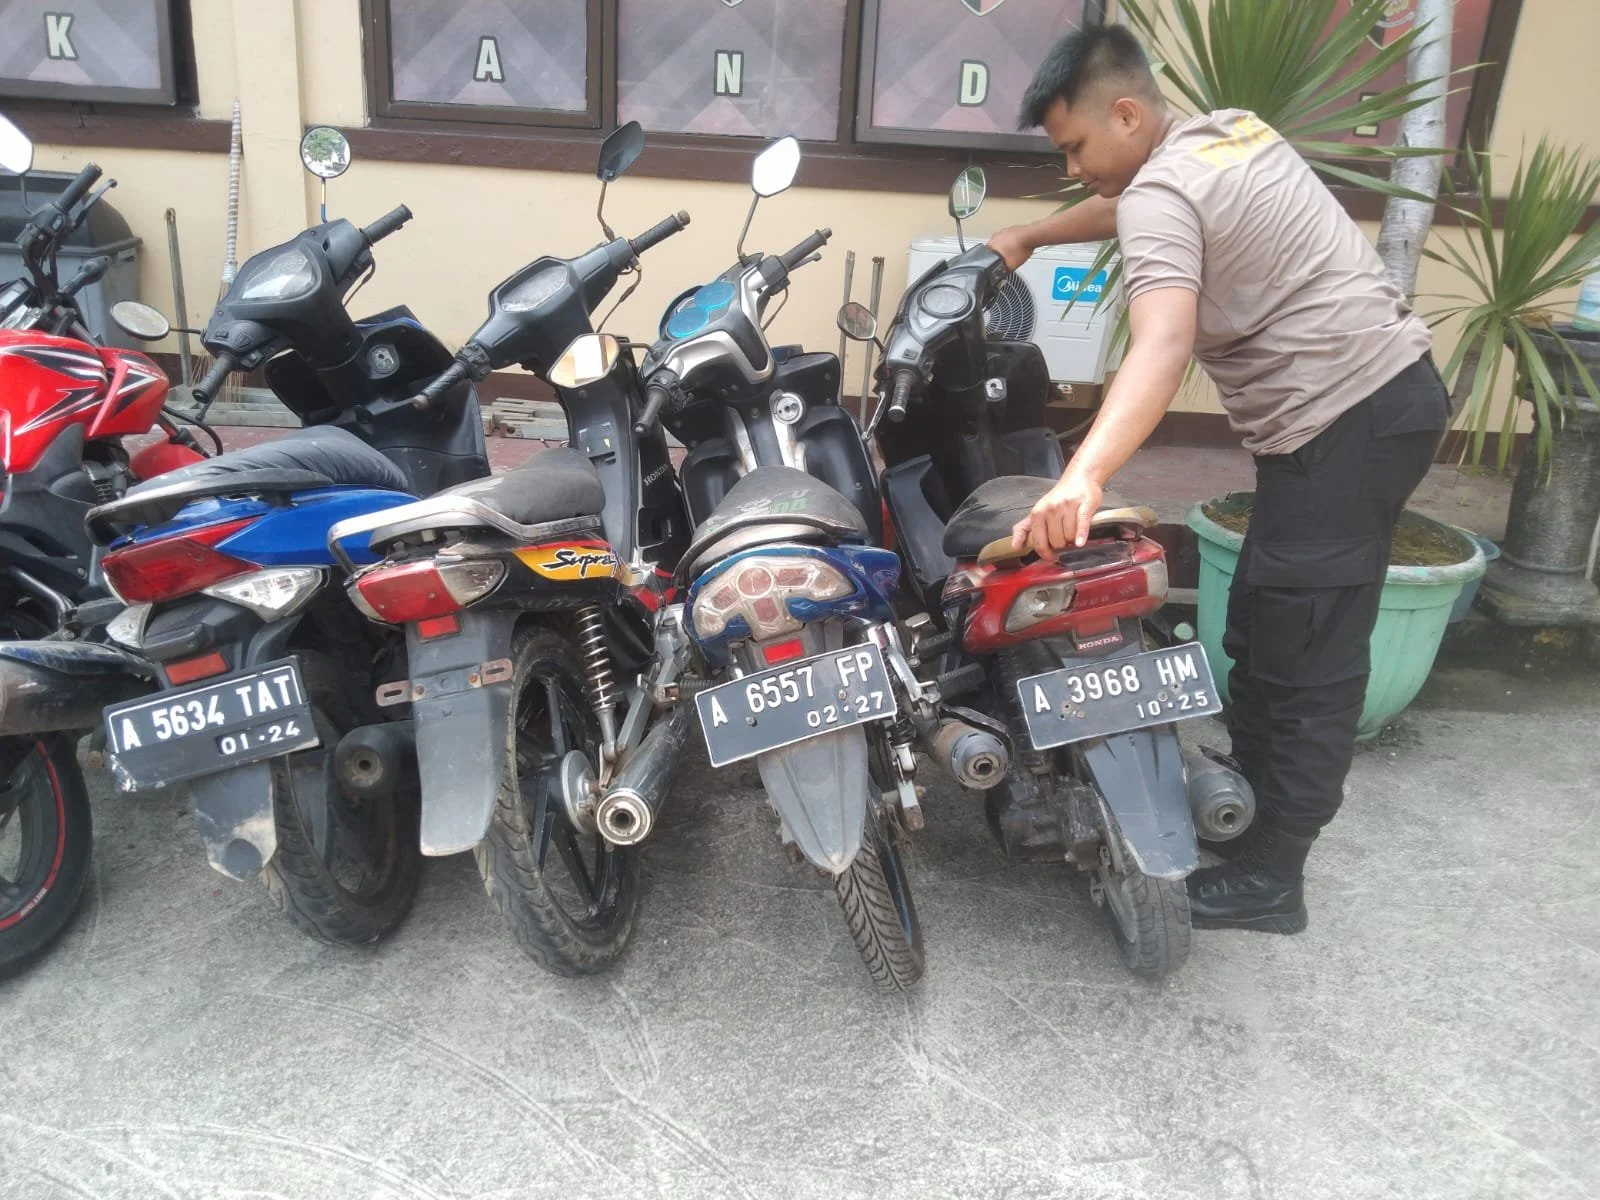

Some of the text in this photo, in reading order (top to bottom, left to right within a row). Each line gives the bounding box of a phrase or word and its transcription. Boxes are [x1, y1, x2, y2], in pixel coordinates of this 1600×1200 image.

[45, 14, 78, 59] K
[474, 38, 504, 81] A
[715, 52, 742, 95] N
[959, 61, 989, 105] D
[1058, 275, 1103, 293] Miea
[1079, 635, 1121, 650] HONDA
[711, 651, 873, 728] A 6557 FP
[1034, 653, 1199, 713] A 3968 HM
[121, 674, 292, 751] A 5634 TAT
